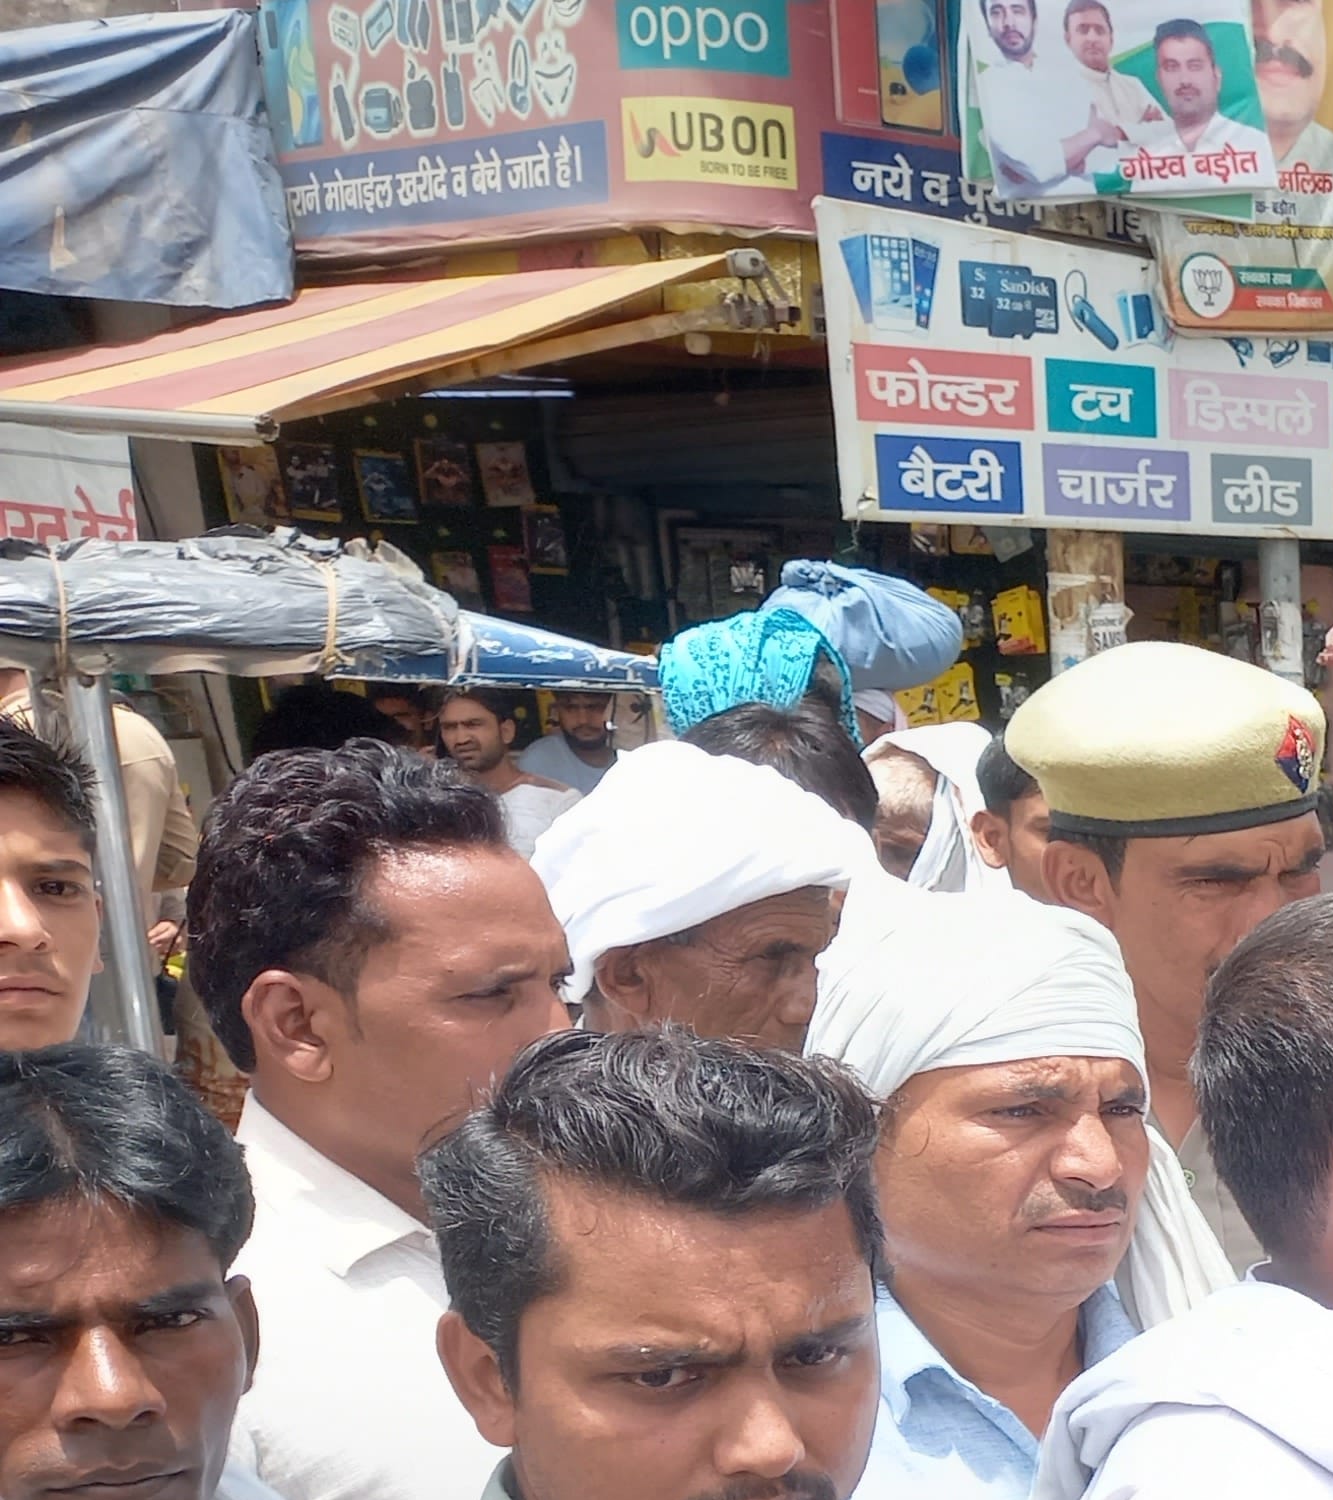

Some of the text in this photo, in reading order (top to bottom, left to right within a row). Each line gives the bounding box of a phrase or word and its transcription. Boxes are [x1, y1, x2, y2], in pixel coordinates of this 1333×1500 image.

[323, 162, 393, 214] मोबाईल
[451, 166, 468, 198] व
[471, 148, 502, 195] बेचे
[505, 141, 551, 189] जाते
[700, 160, 788, 181] BORN TO BE FREE
[851, 153, 913, 201] नये
[920, 172, 951, 206] व
[1120, 146, 1185, 180] गौरव
[996, 297, 1010, 311] 32
[1000, 279, 1050, 297] SanDisk
[865, 358, 1020, 416] फोल्डर
[1069, 383, 1134, 423] टच
[1183, 380, 1316, 437] डिस्पले
[899, 445, 1004, 500] बैटरी
[1057, 459, 1178, 508] चार्जर
[1222, 464, 1302, 517] लीड
